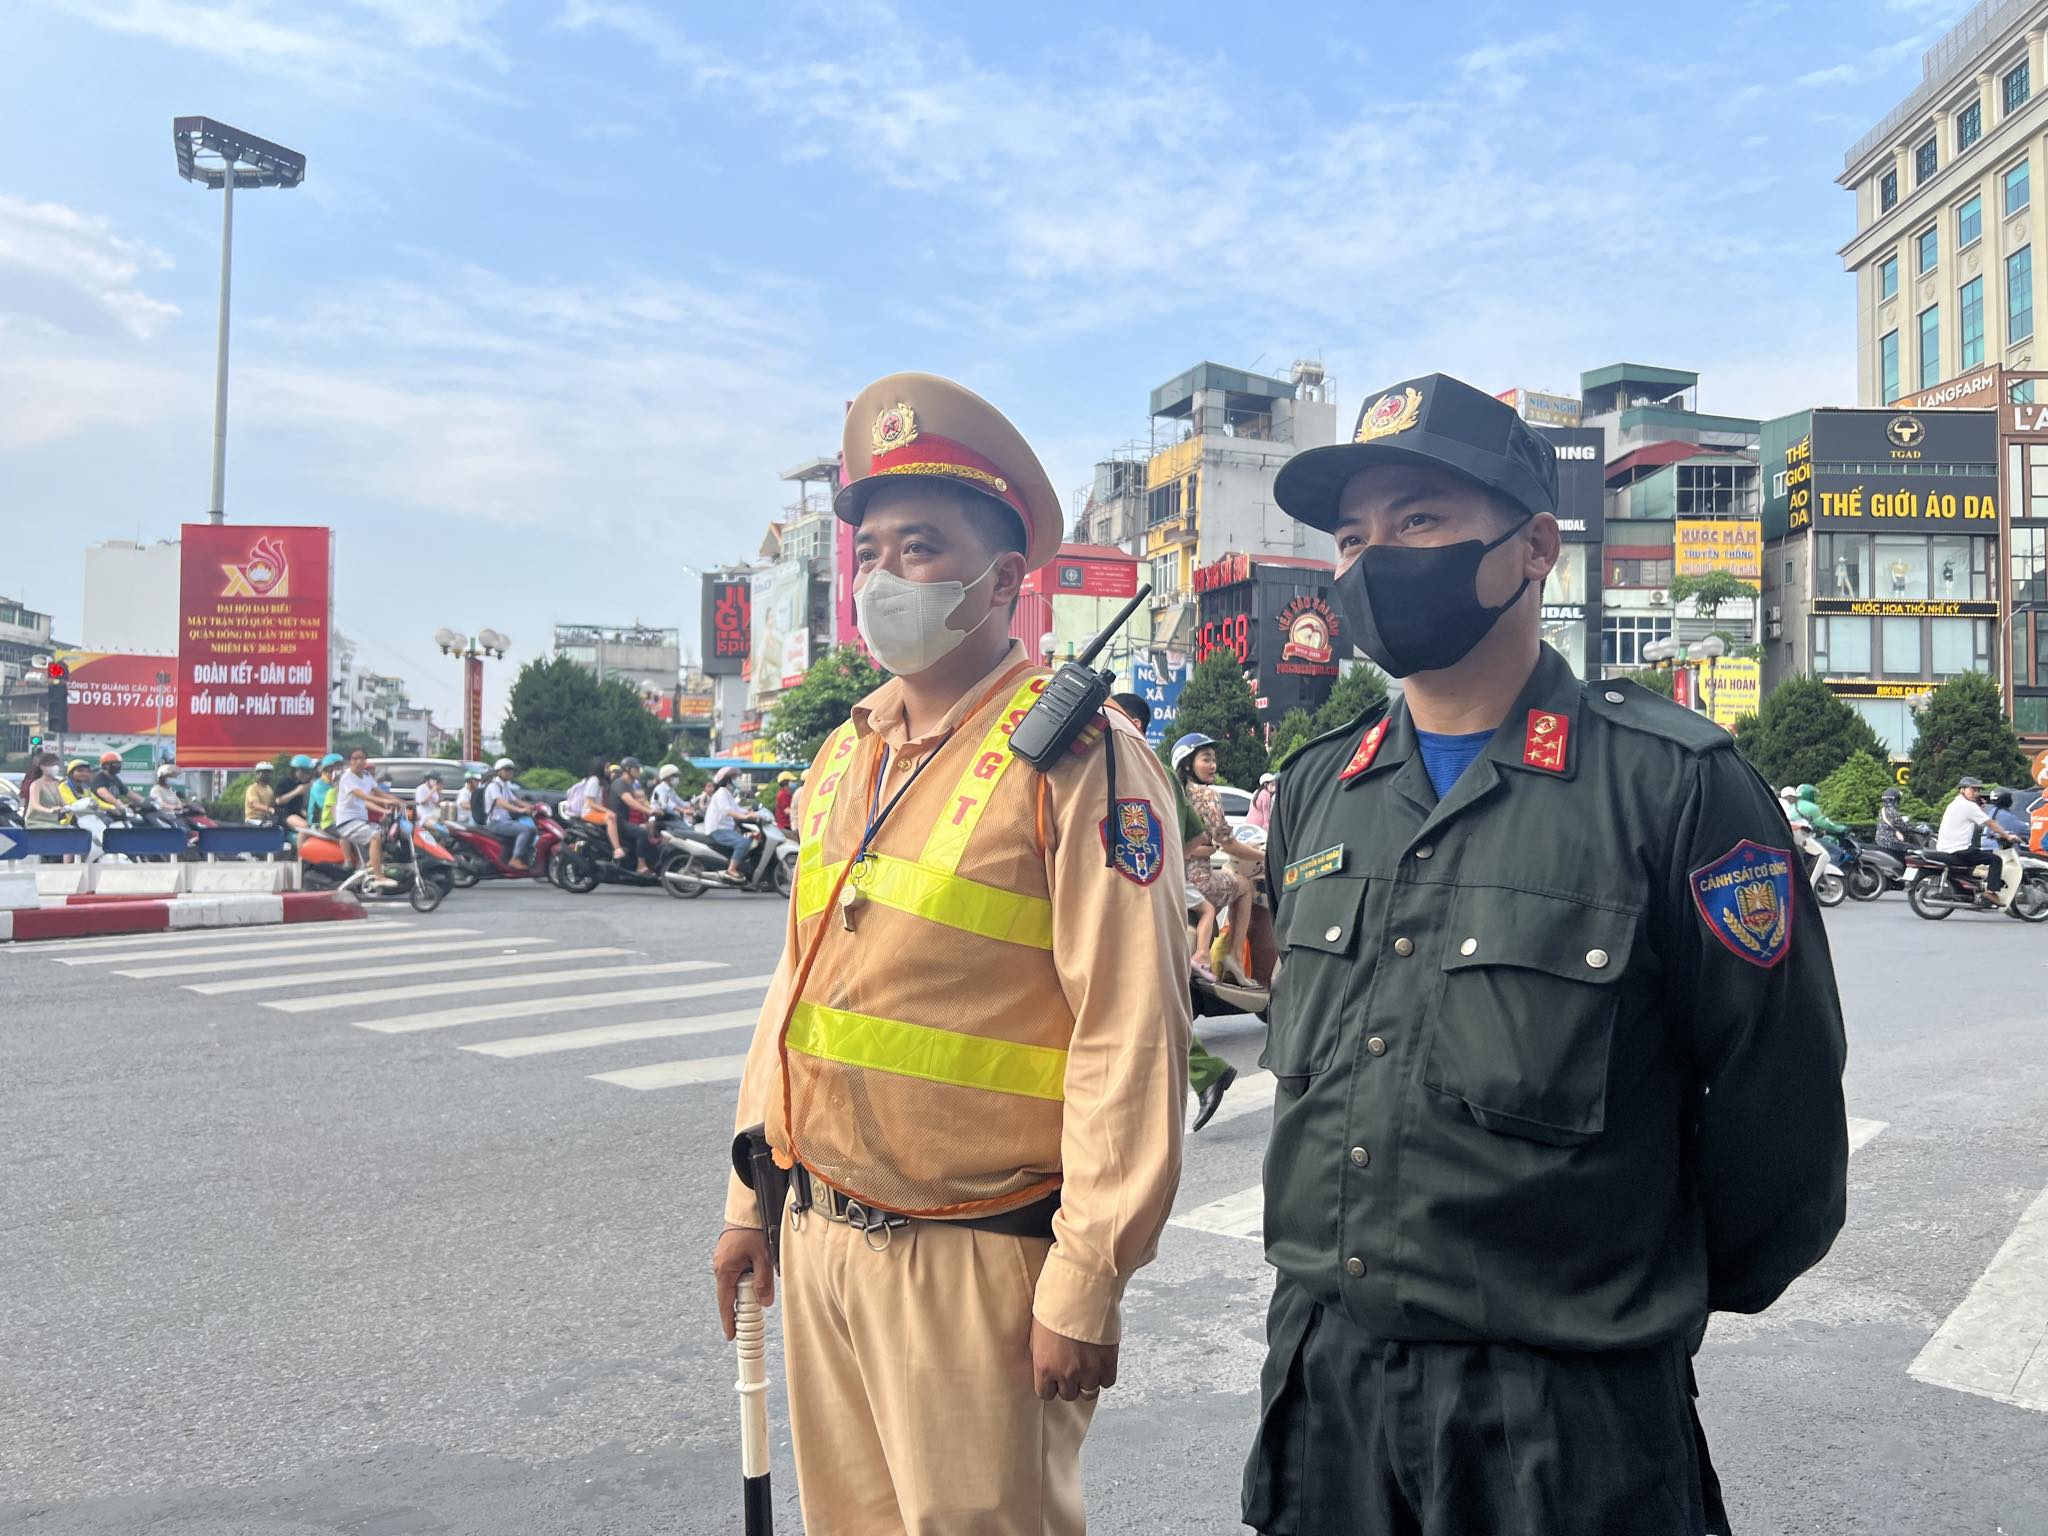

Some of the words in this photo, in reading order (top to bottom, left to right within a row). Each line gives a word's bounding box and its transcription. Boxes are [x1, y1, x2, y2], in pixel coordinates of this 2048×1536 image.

[1786, 434, 1809, 465] THẾ
[1890, 450, 1921, 459] TGAD
[1785, 461, 1811, 487] GIỚI
[1789, 488, 1808, 511] ÁO
[1819, 485, 1864, 517] THẾ
[1871, 488, 1917, 518] GIỚI
[1925, 490, 1956, 519] ÁO
[1964, 495, 1996, 520] DA
[1790, 508, 1808, 529] DA
[1882, 604, 1904, 613] HOA
[194, 661, 228, 684] ĐOÀN
[230, 659, 253, 684] KẾT
[260, 662, 285, 684] DÂN
[288, 660, 313, 685] CHỦ
[1138, 668, 1177, 683] NGN
[82, 690, 177, 708] 098.197.608
[191, 688, 211, 714] ĐỔI
[215, 692, 238, 714] MỚI
[246, 692, 280, 715] PHÁT
[280, 689, 315, 716] TRIỂN
[1145, 686, 1164, 701] XÃ
[1700, 873, 1733, 892] CẢNH
[1732, 865, 1754, 884] SÁT
